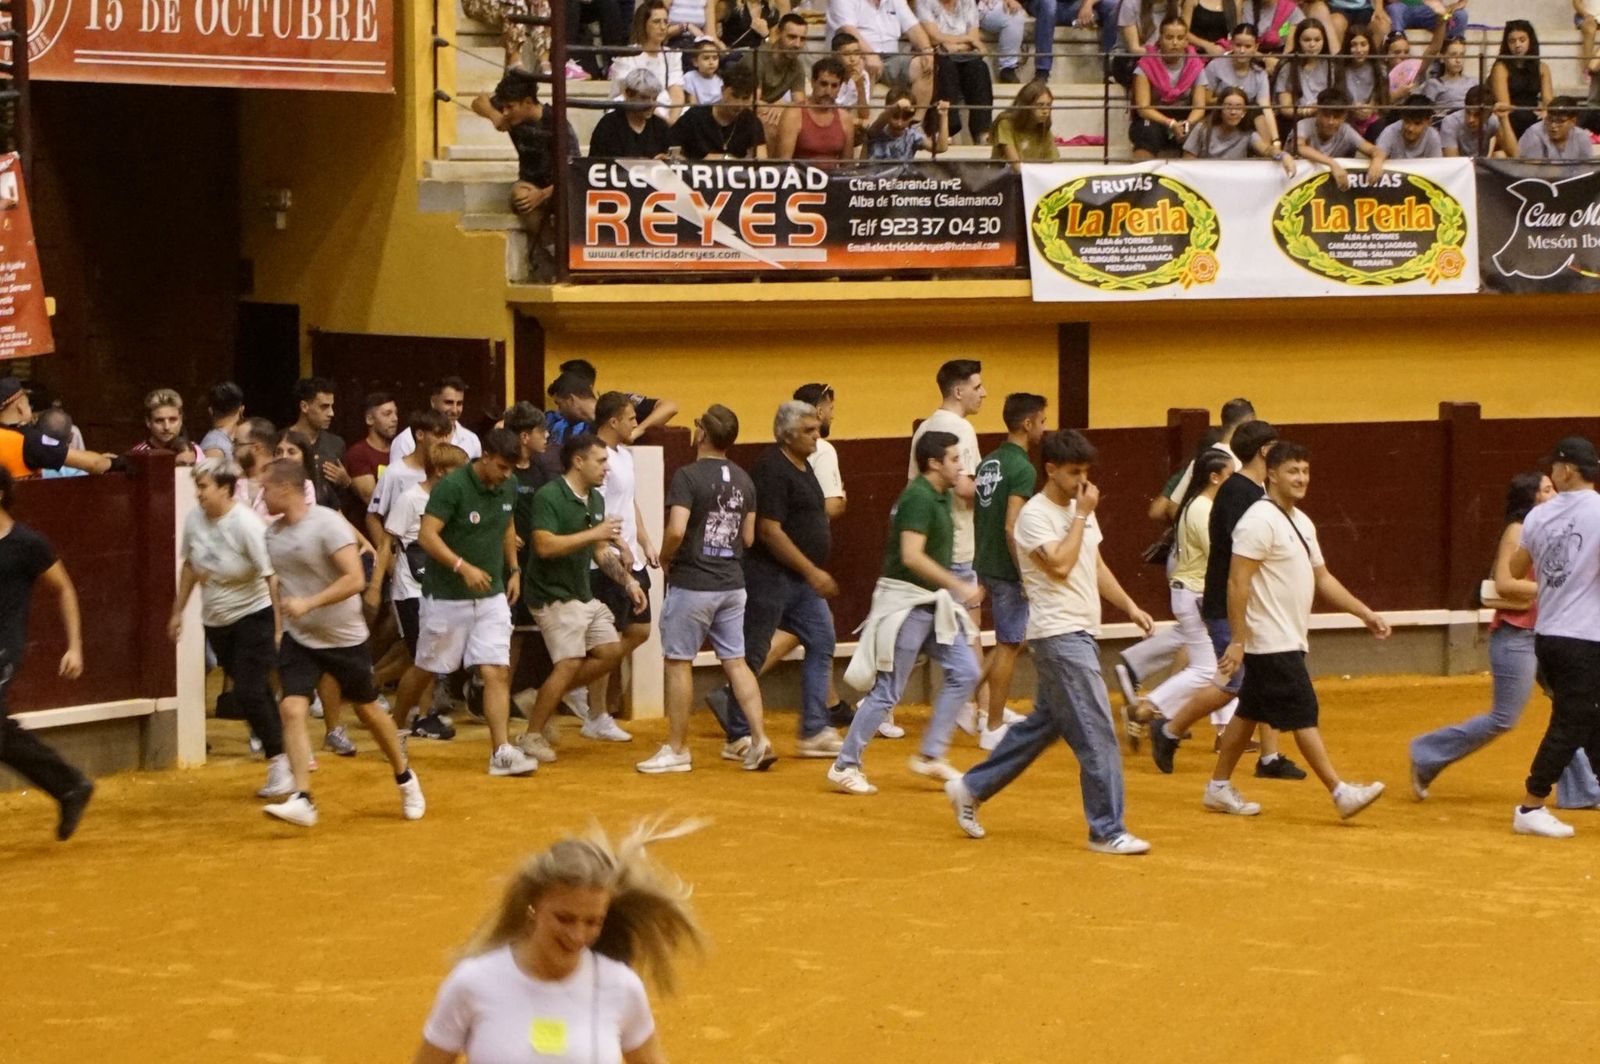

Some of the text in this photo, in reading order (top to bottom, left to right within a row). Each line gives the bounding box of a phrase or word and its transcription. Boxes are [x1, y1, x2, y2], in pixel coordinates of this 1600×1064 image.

[84, 0, 378, 42] 15 DE OCTUBRE
[588, 164, 828, 190] ELECTRICIDAD
[1092, 177, 1152, 193] FRUTAS
[1347, 173, 1402, 188] RUAS
[849, 193, 1003, 207] Alba de Tormes (Salamanca)
[586, 190, 828, 246] REYES
[1065, 199, 1189, 236] La Perla
[1311, 196, 1435, 232] La Perla
[1525, 203, 1566, 228] Casa
[849, 217, 1001, 236] Telf 923 37 04 30
[1528, 234, 1577, 249] Mesón
[588, 250, 741, 260] www.electricidadreyes.com
